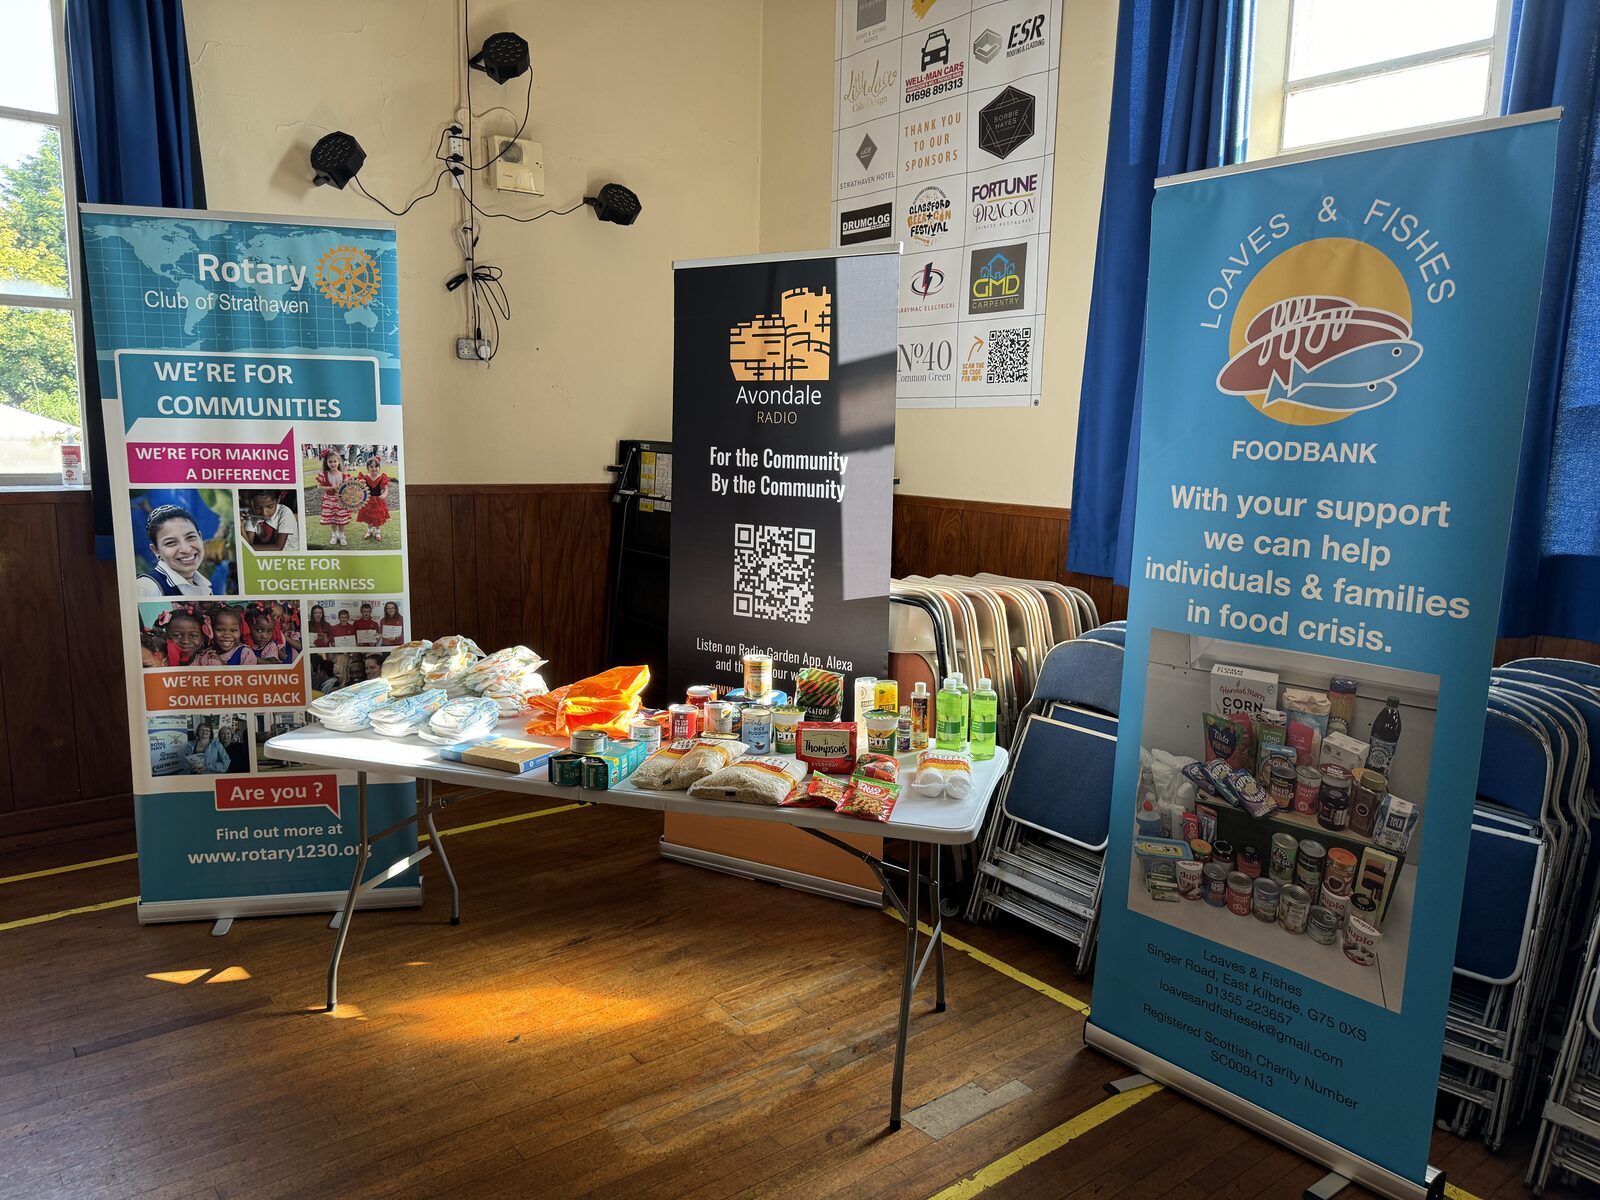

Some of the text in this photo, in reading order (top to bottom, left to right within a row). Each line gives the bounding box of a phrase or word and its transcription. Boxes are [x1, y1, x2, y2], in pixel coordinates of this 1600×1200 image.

[1007, 14, 1045, 49] ESR
[905, 69, 943, 87] WELL-MAN
[943, 62, 965, 75] CARS
[905, 87, 931, 103] 01698
[932, 77, 963, 95] 891313
[904, 112, 962, 138] THANK YOU
[994, 109, 1019, 123] SORBIE
[913, 135, 950, 152] TO OUR
[905, 149, 959, 172] SPONSORS
[839, 171, 895, 190] STRATHAVEN HOTEL
[972, 174, 1038, 202] FORTUNE
[909, 199, 951, 215] GLASSFORD
[973, 197, 1036, 223] DRAGON
[842, 213, 890, 231] DRUMCLOG
[910, 221, 949, 238] FESTIVAL
[198, 253, 308, 291] Rotary
[1200, 196, 1457, 329] LOAVES & FISHES
[973, 275, 1020, 298] GMD
[144, 290, 309, 314] Club of Strathaven
[898, 302, 955, 313] RAYMAC ELECTRICAL
[972, 297, 1019, 309] CARPENTRY
[153, 361, 294, 385] WE'RE FOR
[928, 372, 952, 382] Green
[735, 384, 823, 406] Avondale
[156, 395, 342, 419] COMMUNITIES
[757, 411, 798, 424] RADIO
[135, 447, 290, 462] WE'RE FOR MAKING
[710, 446, 849, 475] For the Community
[1231, 440, 1379, 464] FOODBANK
[185, 468, 291, 482] A DIFFERENCE
[711, 472, 846, 503] By the Community
[1171, 484, 1452, 529] With your support
[1203, 530, 1392, 572] we can help
[256, 557, 341, 571] WE'RE FOR
[257, 578, 376, 591] TOGETHERNESS
[1145, 556, 1471, 620] individuals & families
[1186, 598, 1393, 654] in food crisis.
[696, 637, 853, 672] Listen on Radio Garden App, Alexa
[715, 658, 732, 673] and
[162, 673, 300, 689] WE'RE FOR GIVING
[168, 692, 301, 707] SOMETHING BACK
[1222, 696, 1264, 713] CORN
[804, 706, 830, 716] GATONI
[1213, 728, 1230, 744] Tilda
[1263, 734, 1281, 744] LONG
[804, 738, 848, 757] Thompson's
[229, 782, 324, 803] Are you ?
[216, 823, 344, 841] Find out more at
[1319, 891, 1345, 910] duplo
[1353, 916, 1376, 933] duplo
[1203, 948, 1303, 998] Loaves & Fishes
[1147, 943, 1183, 967] Singer
[1185, 959, 1218, 982] Road,
[1222, 972, 1249, 994] East
[1252, 986, 1303, 1017] Kilbride,
[1307, 1008, 1335, 1029] G75
[1205, 982, 1293, 1027] 01355 223657
[1159, 978, 1344, 1069] loavesandfishesek@gmail.com
[1143, 1003, 1360, 1110] Registered Scottish Charity Number
[1210, 1049, 1275, 1088] SC009413
